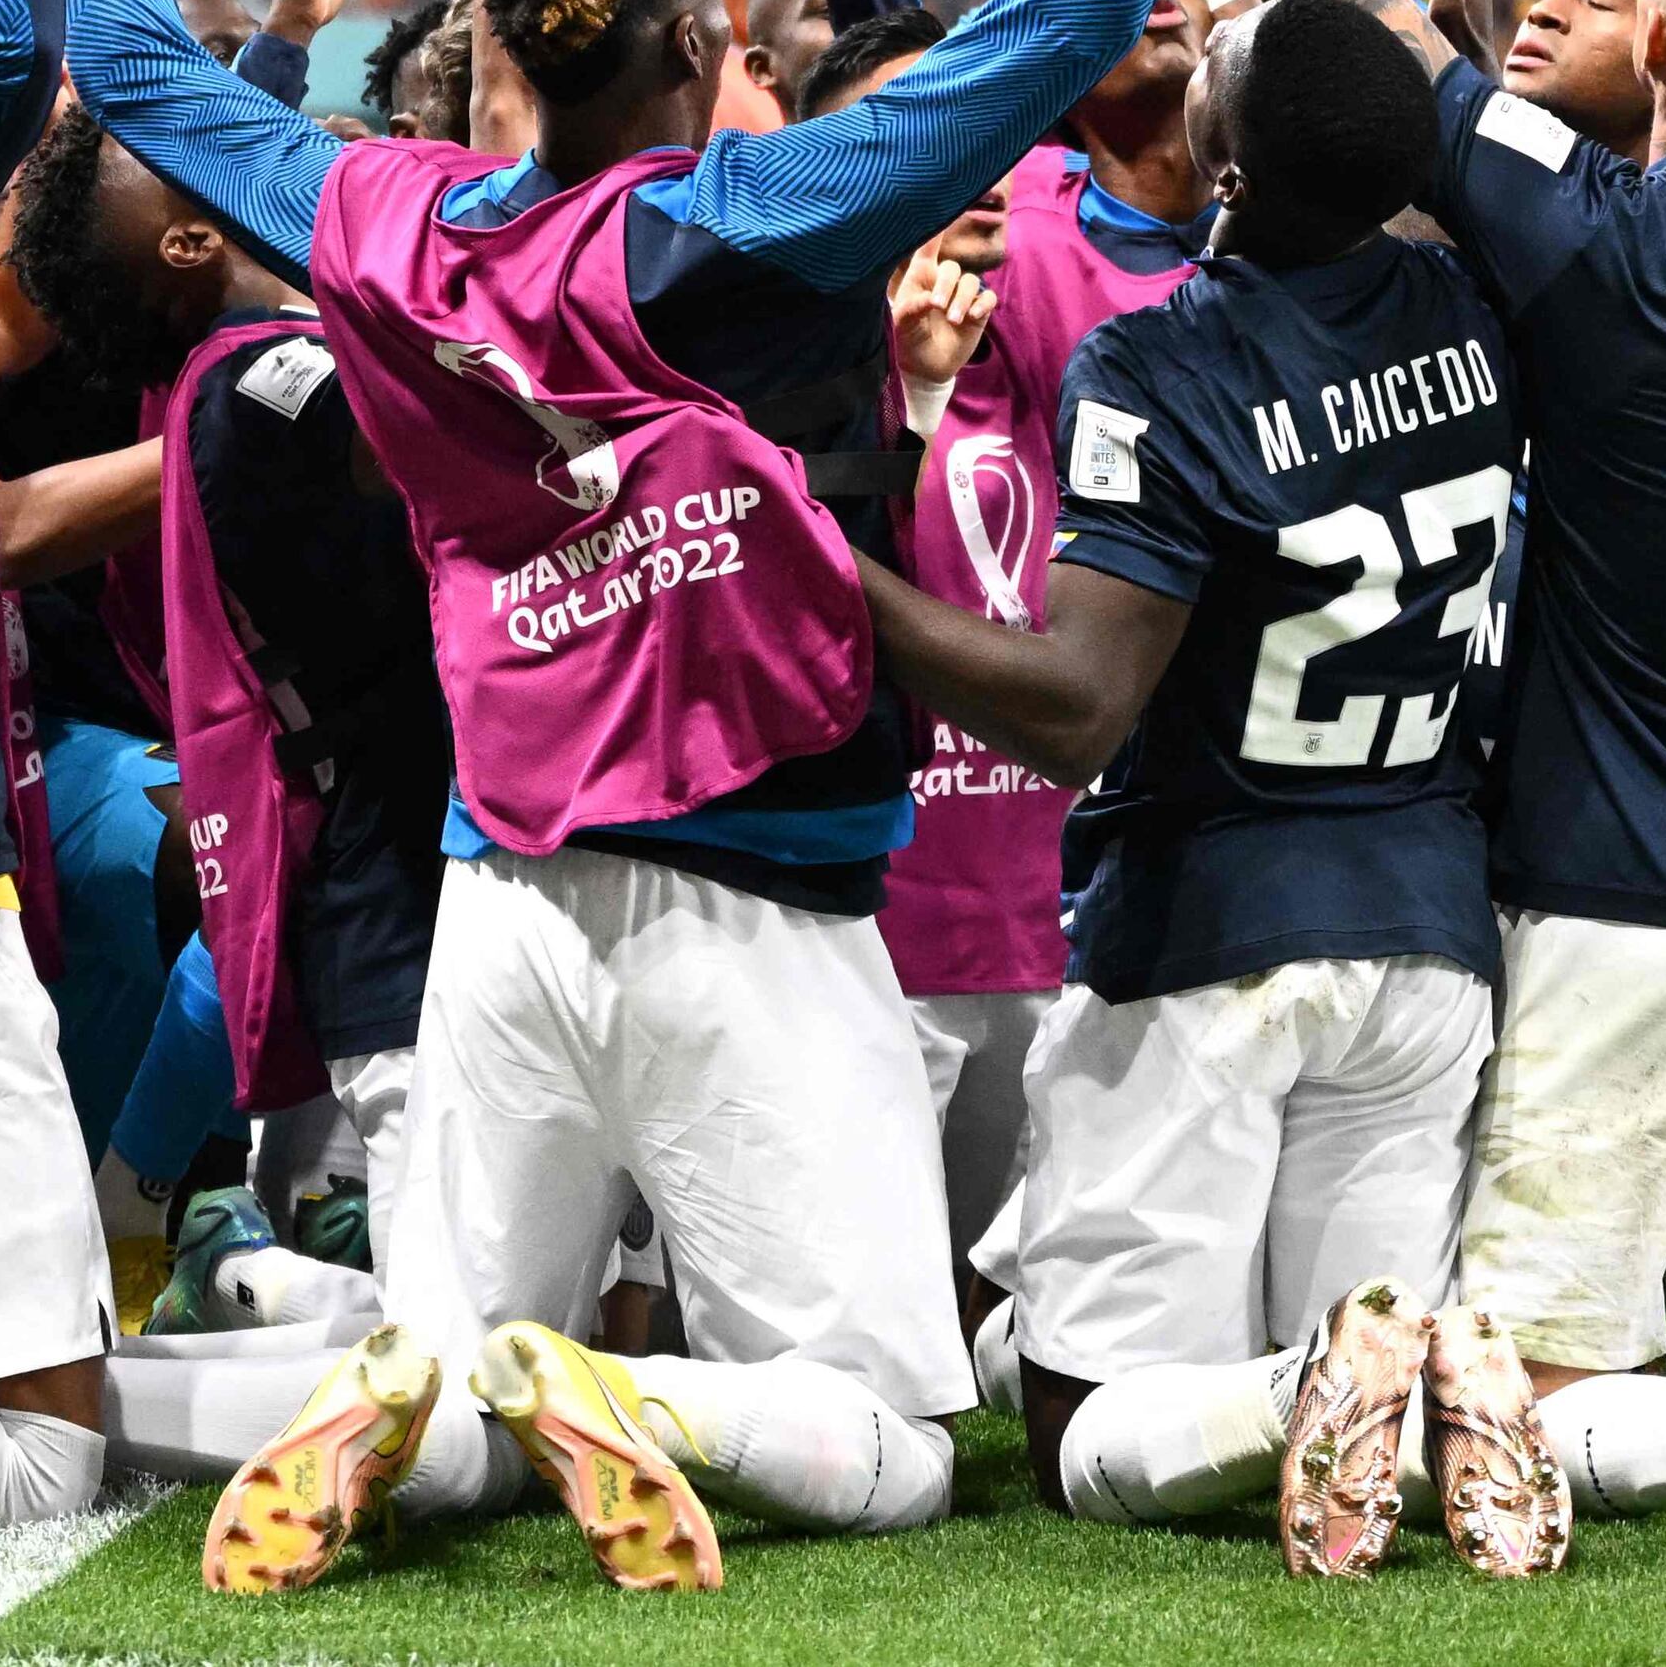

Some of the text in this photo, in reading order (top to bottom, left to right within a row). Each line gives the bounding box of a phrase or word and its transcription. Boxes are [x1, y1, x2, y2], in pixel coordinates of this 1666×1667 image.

[1253, 338, 1498, 475] M. CAICEDO
[491, 486, 761, 613] FIFA WORLD CUP
